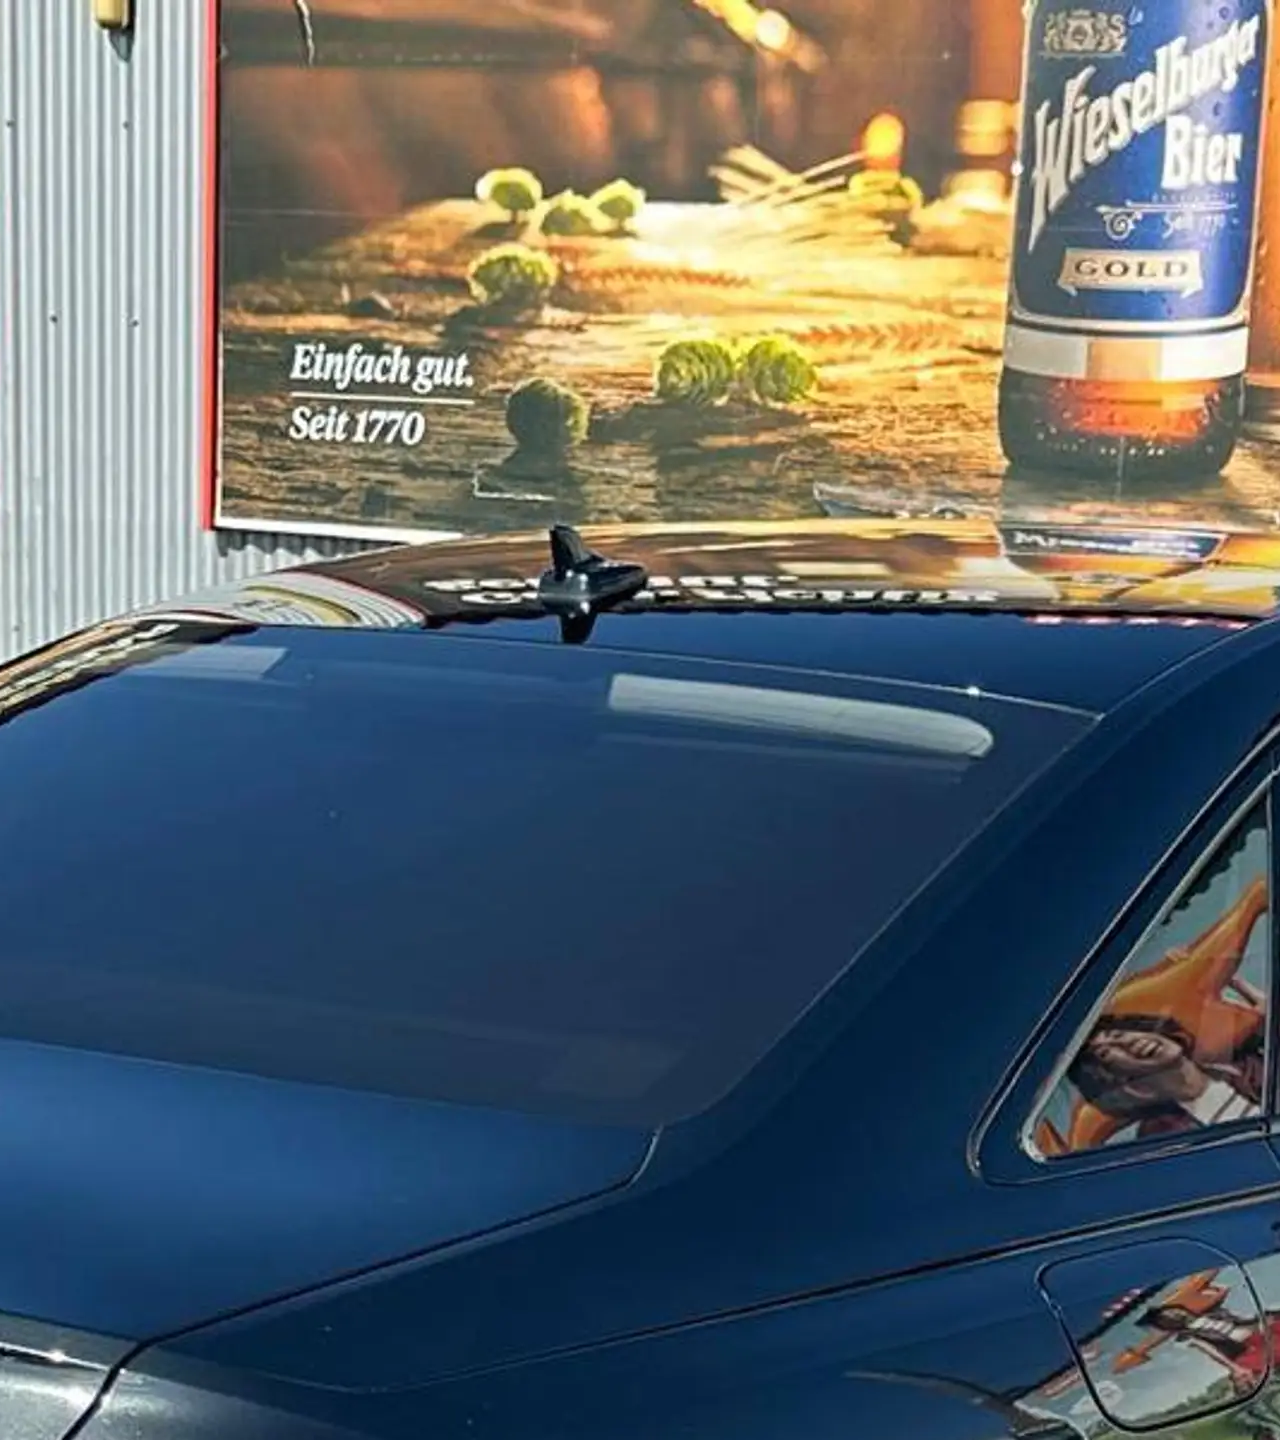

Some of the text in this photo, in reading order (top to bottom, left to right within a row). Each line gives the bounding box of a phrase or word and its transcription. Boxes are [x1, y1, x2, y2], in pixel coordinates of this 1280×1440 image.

[1029, 14, 1259, 254] Wieselburger
[1162, 115, 1242, 190] Bier
[1074, 258, 1189, 278] GOLD
[289, 343, 475, 394] Einfach gut.
[288, 406, 426, 447] Seit 1770
